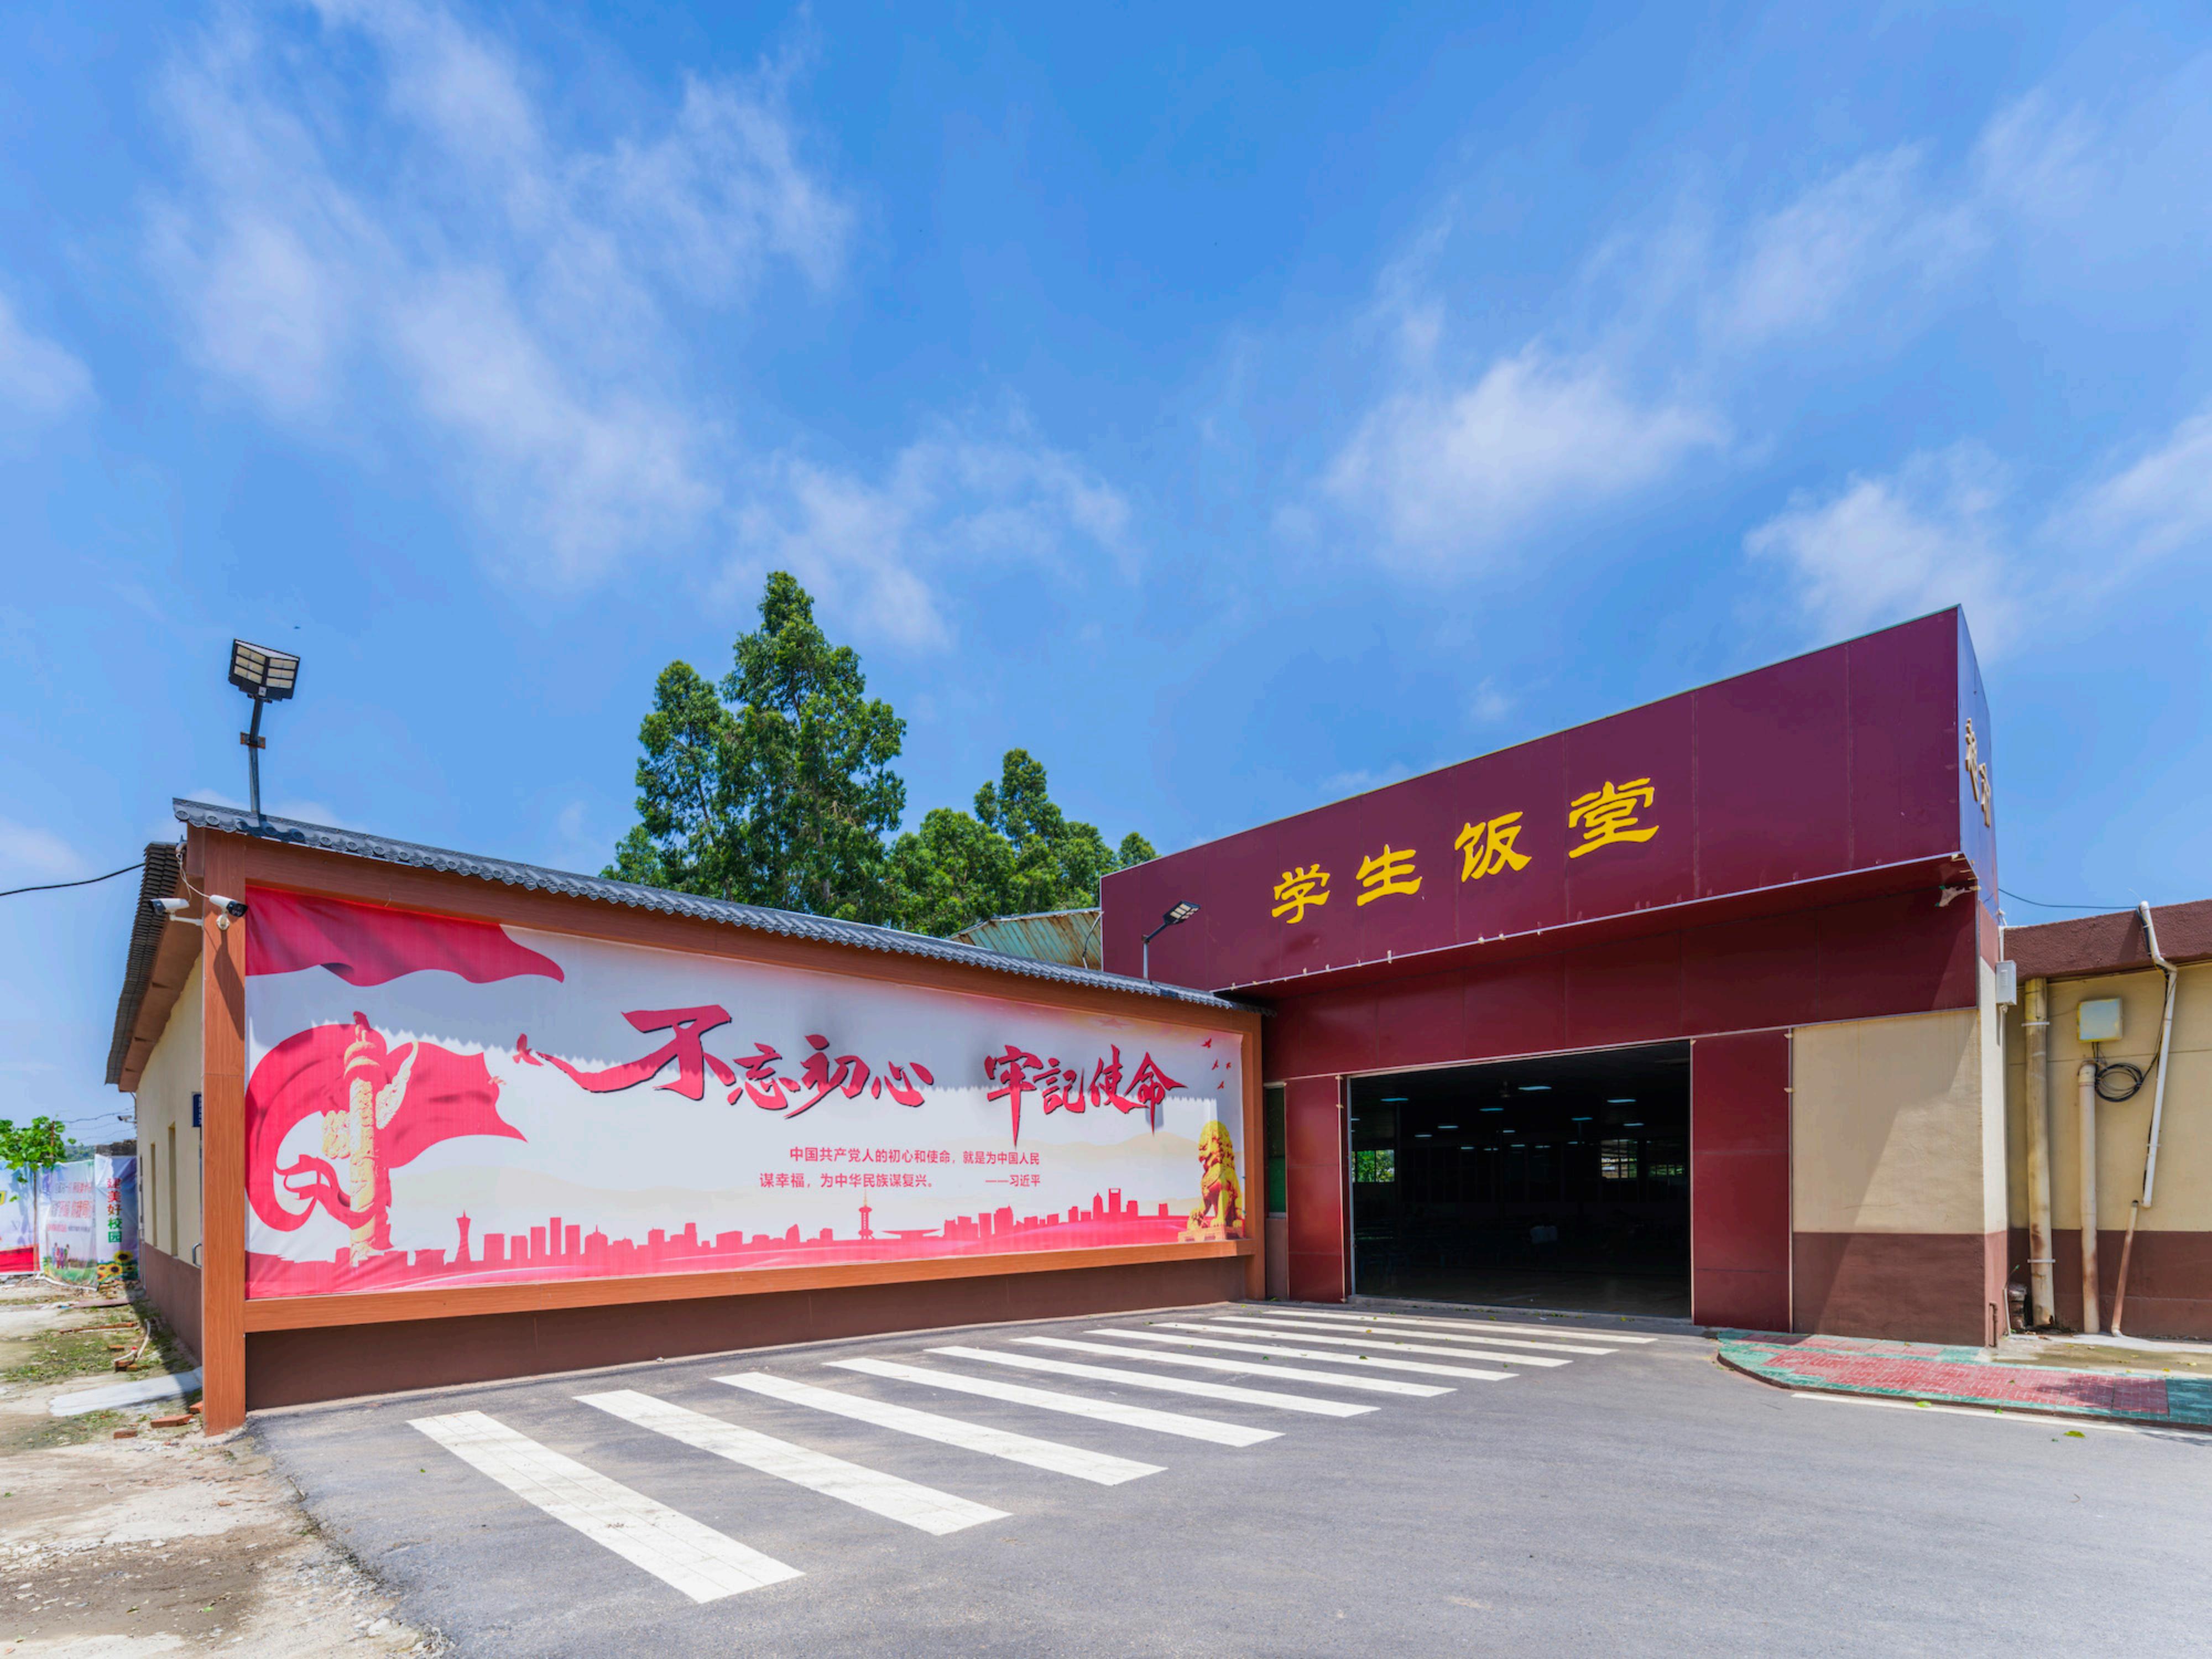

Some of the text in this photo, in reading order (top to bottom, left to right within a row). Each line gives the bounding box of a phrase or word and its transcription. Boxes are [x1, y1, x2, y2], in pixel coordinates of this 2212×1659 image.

[1271, 778, 1659, 924] 学生饭堂
[535, 1004, 934, 1119] 不忘初心
[107, 1177, 122, 1243] 建美好校园
